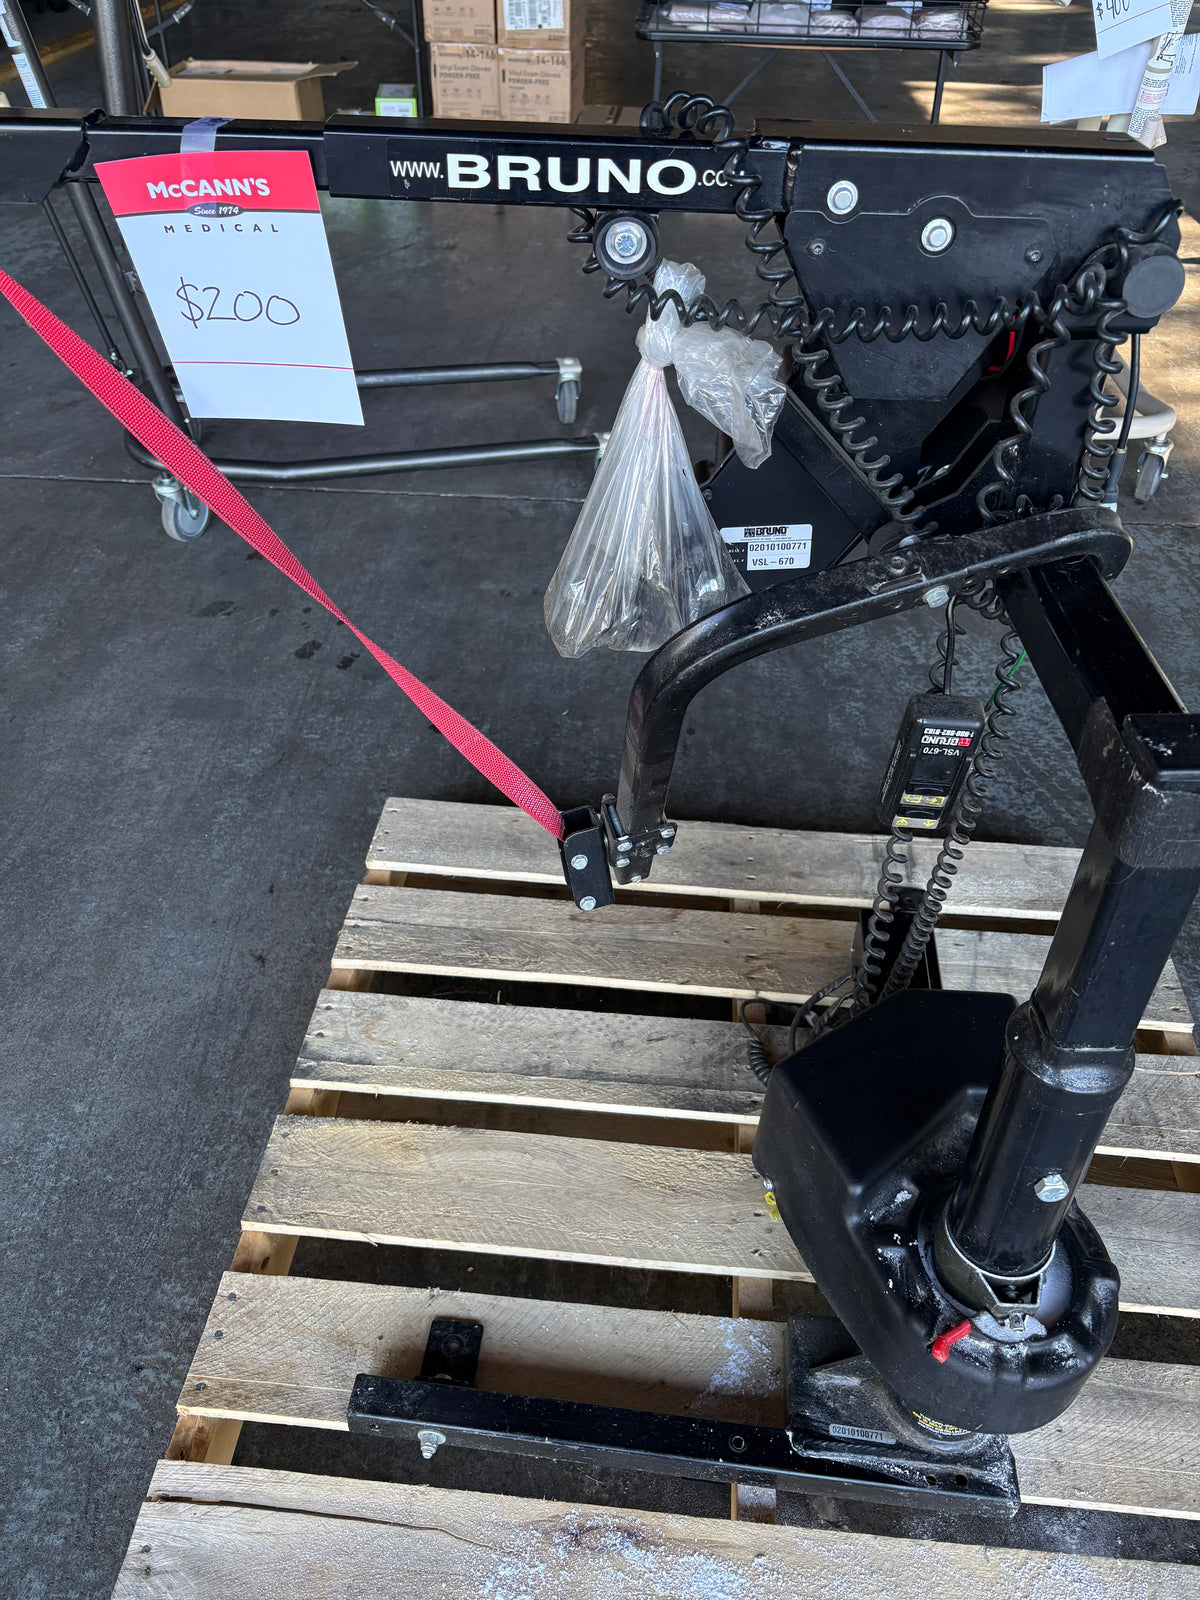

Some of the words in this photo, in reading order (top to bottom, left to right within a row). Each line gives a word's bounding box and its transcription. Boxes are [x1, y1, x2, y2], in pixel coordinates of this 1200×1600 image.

[390, 153, 745, 195] www.BRUNO.co
[146, 178, 270, 199] McCANN'S
[194, 206, 216, 215] Since
[218, 206, 240, 215] 1974
[164, 224, 279, 233] MEDICAL
[176, 276, 301, 329] $200
[756, 526, 787, 536] BRUNO
[749, 542, 807, 552] 02010100771
[921, 734, 960, 746] BRUNO
[922, 746, 960, 757] VSL-670
